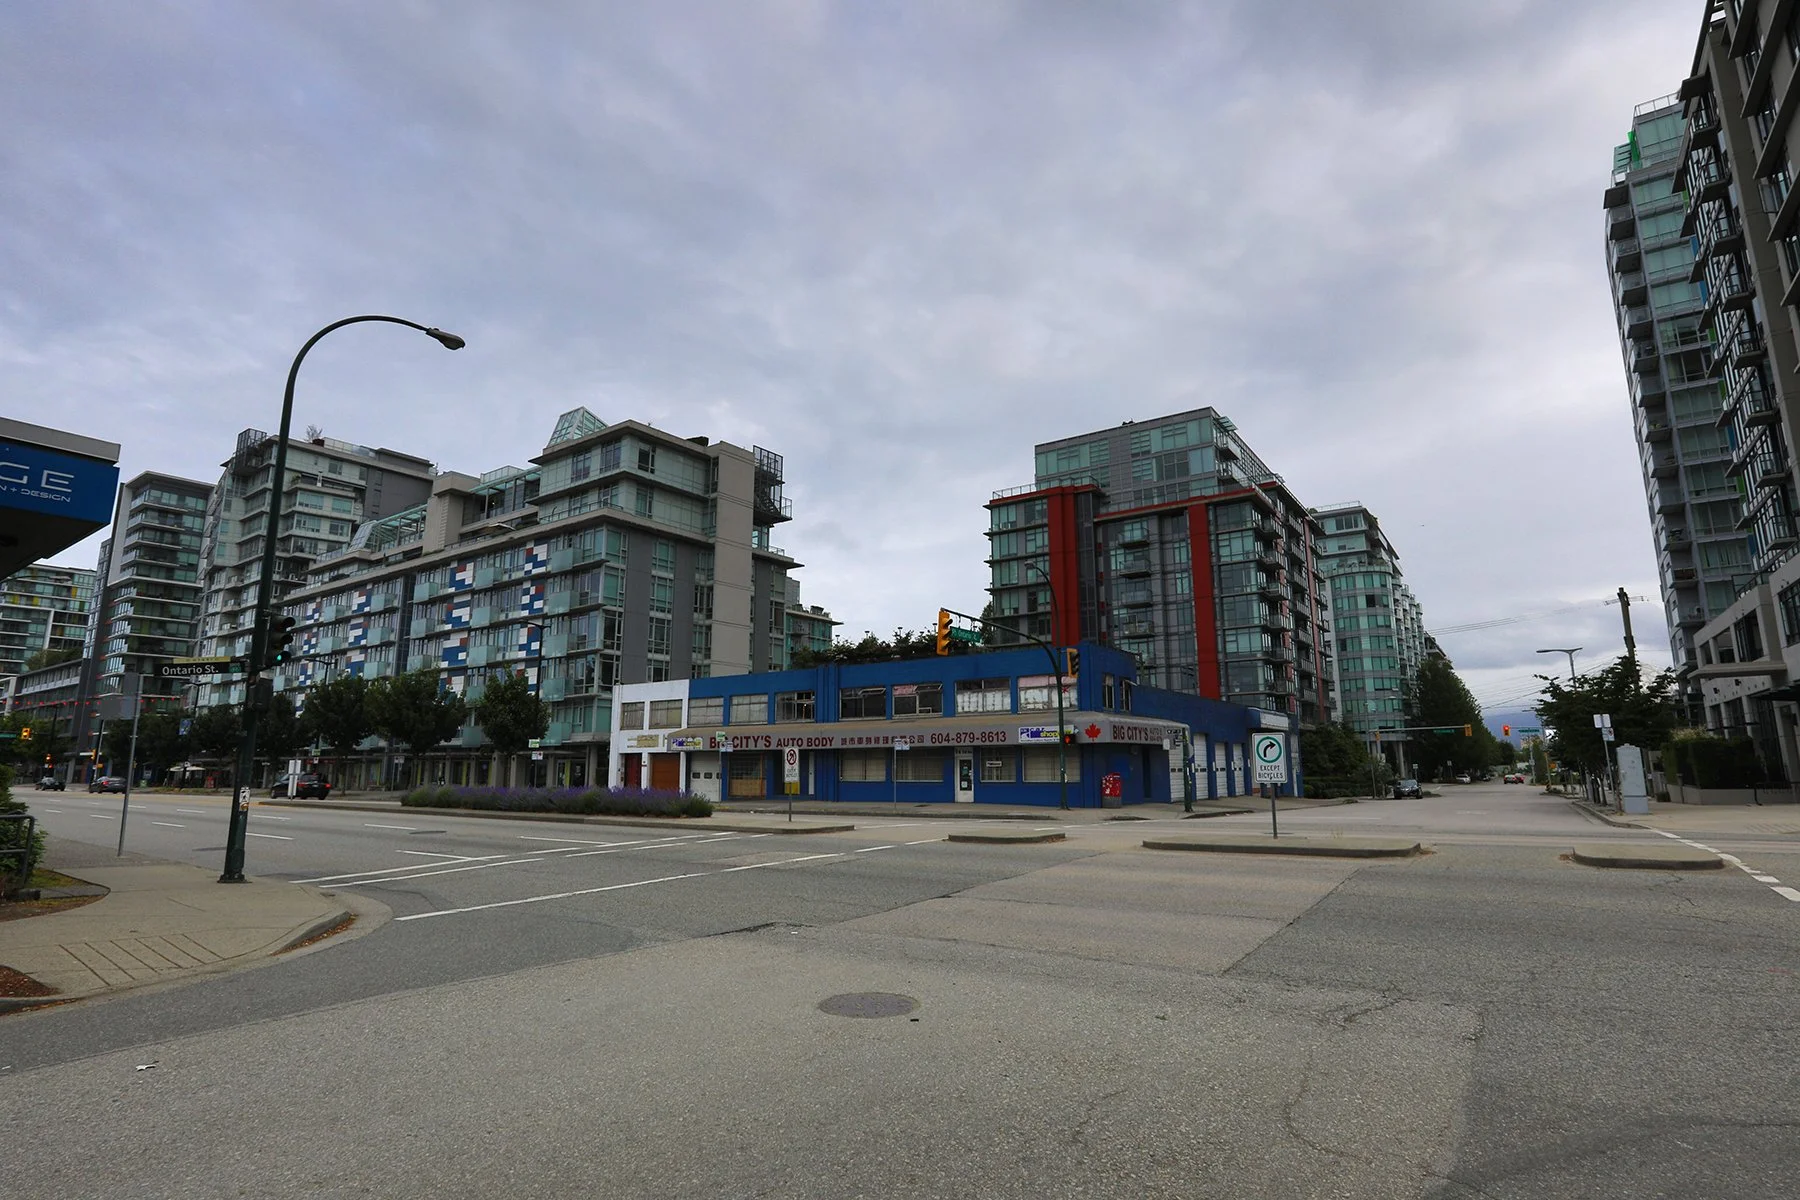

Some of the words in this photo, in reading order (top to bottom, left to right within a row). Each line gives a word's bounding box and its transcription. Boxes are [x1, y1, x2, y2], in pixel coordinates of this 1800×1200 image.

[21, 488, 71, 502] DESIGN
[162, 665, 202, 675] Ontario
[204, 665, 219, 673] St.
[930, 731, 1006, 744] 604-879-8613
[1112, 725, 1125, 739] BIG
[1126, 726, 1149, 741] CITY'S
[732, 735, 771, 748] CITY'S
[776, 737, 803, 748] AUTO
[806, 736, 834, 747] BODY
